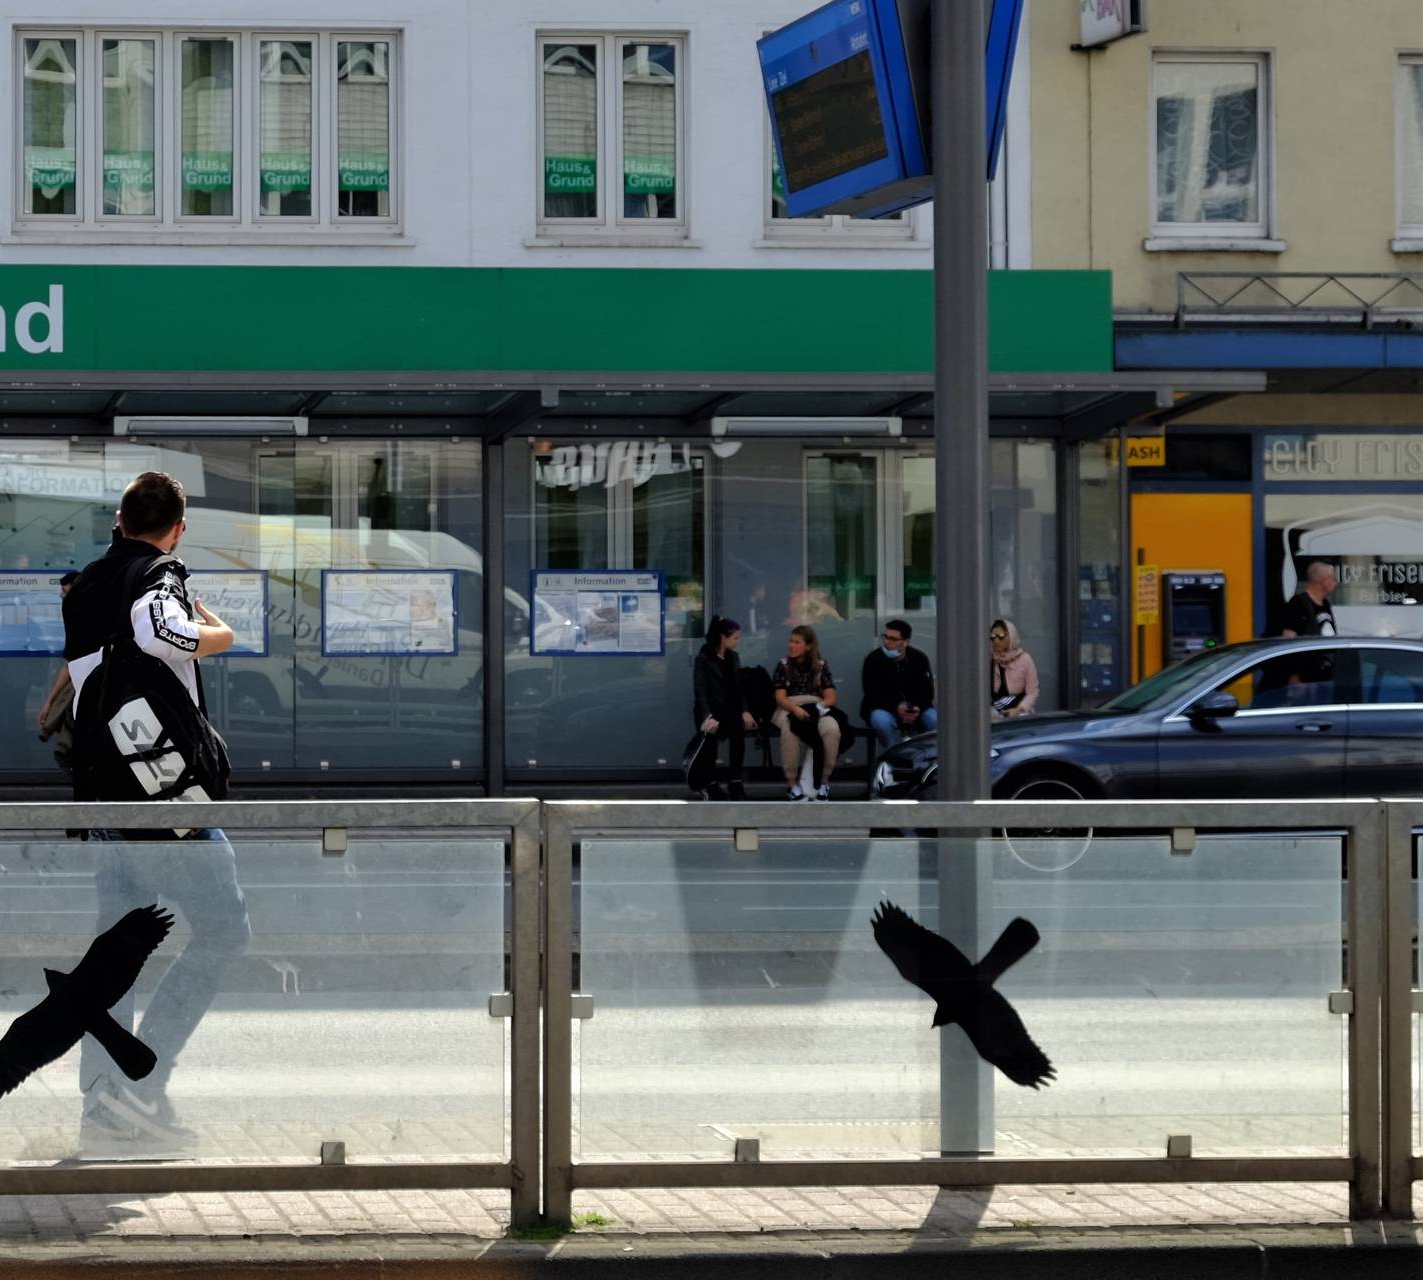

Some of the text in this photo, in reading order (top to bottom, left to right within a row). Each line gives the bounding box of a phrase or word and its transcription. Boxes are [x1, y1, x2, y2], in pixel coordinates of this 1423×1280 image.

[186, 172, 231, 185] Grund
[264, 172, 309, 185] Grund
[342, 172, 388, 185] Grund
[549, 173, 595, 187] Grund
[629, 174, 674, 188] Grund
[1127, 446, 1162, 459] ASH
[574, 577, 627, 586] Information
